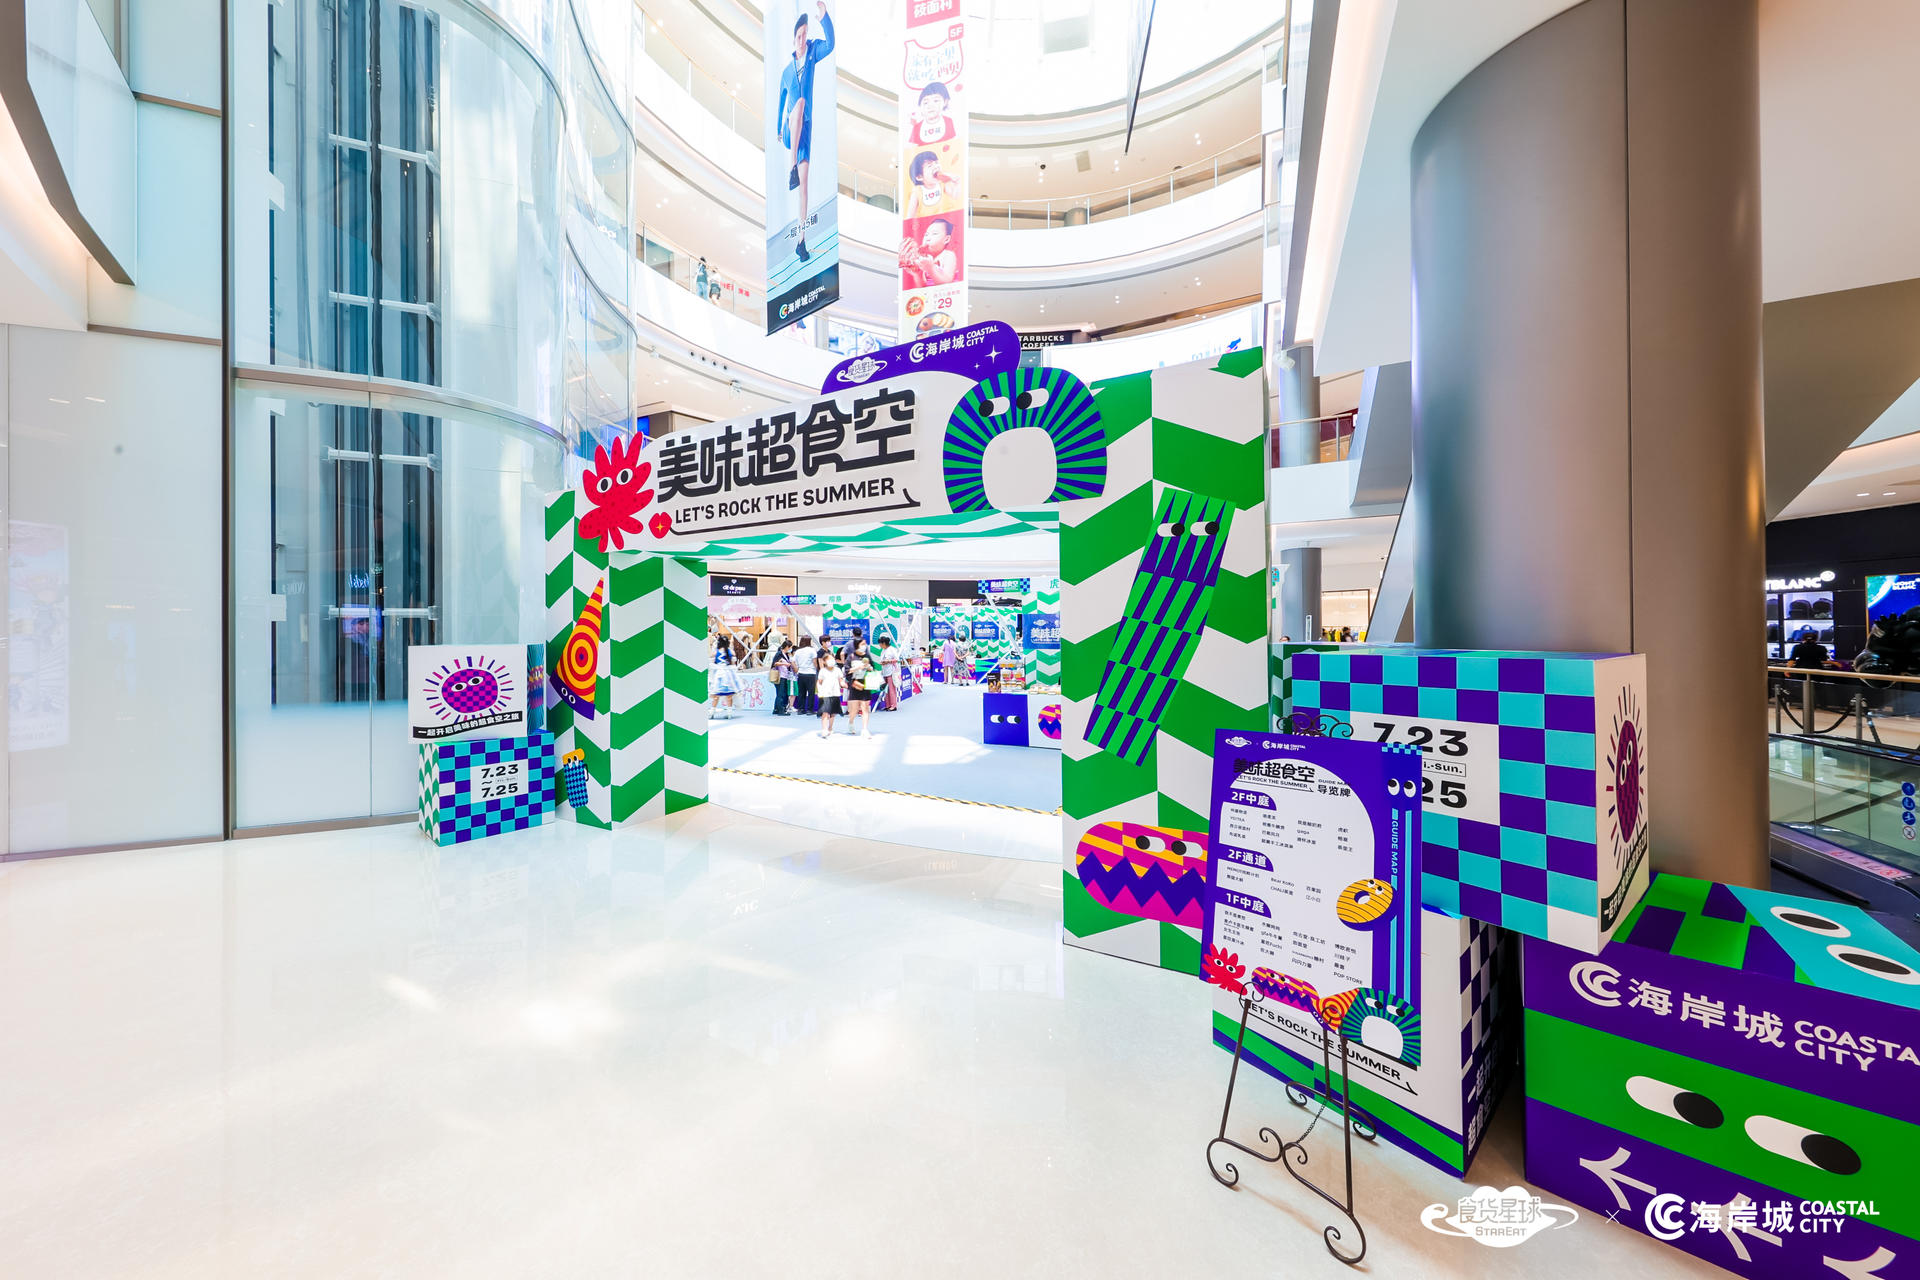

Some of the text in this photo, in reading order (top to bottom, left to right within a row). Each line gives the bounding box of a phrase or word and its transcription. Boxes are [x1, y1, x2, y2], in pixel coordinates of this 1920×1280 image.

[937, 297, 953, 309] 29
[966, 325, 999, 340] COASTAL
[966, 335, 985, 348] CITY
[925, 334, 965, 358] 海岸城
[657, 387, 915, 504] 美味超食空
[675, 477, 895, 524] LET'S ROCK THE SUMMER
[481, 764, 519, 779] 7.23
[481, 782, 519, 798] 7.25
[1280, 780, 1308, 789] SUMMER
[1317, 784, 1351, 797] 导览牌
[1231, 791, 1270, 807] 2F中庭
[1391, 820, 1399, 849] GUIDE
[1227, 849, 1267, 867] 2F通道
[1226, 893, 1265, 914] 1F中庭
[1627, 977, 1787, 1049] 海岸城
[1251, 1003, 1275, 1020] ET'S
[1277, 1015, 1308, 1037] ROCK
[1310, 1031, 1335, 1049] THE
[1794, 1020, 1920, 1067] COASTA
[1794, 1039, 1876, 1072] CITY
